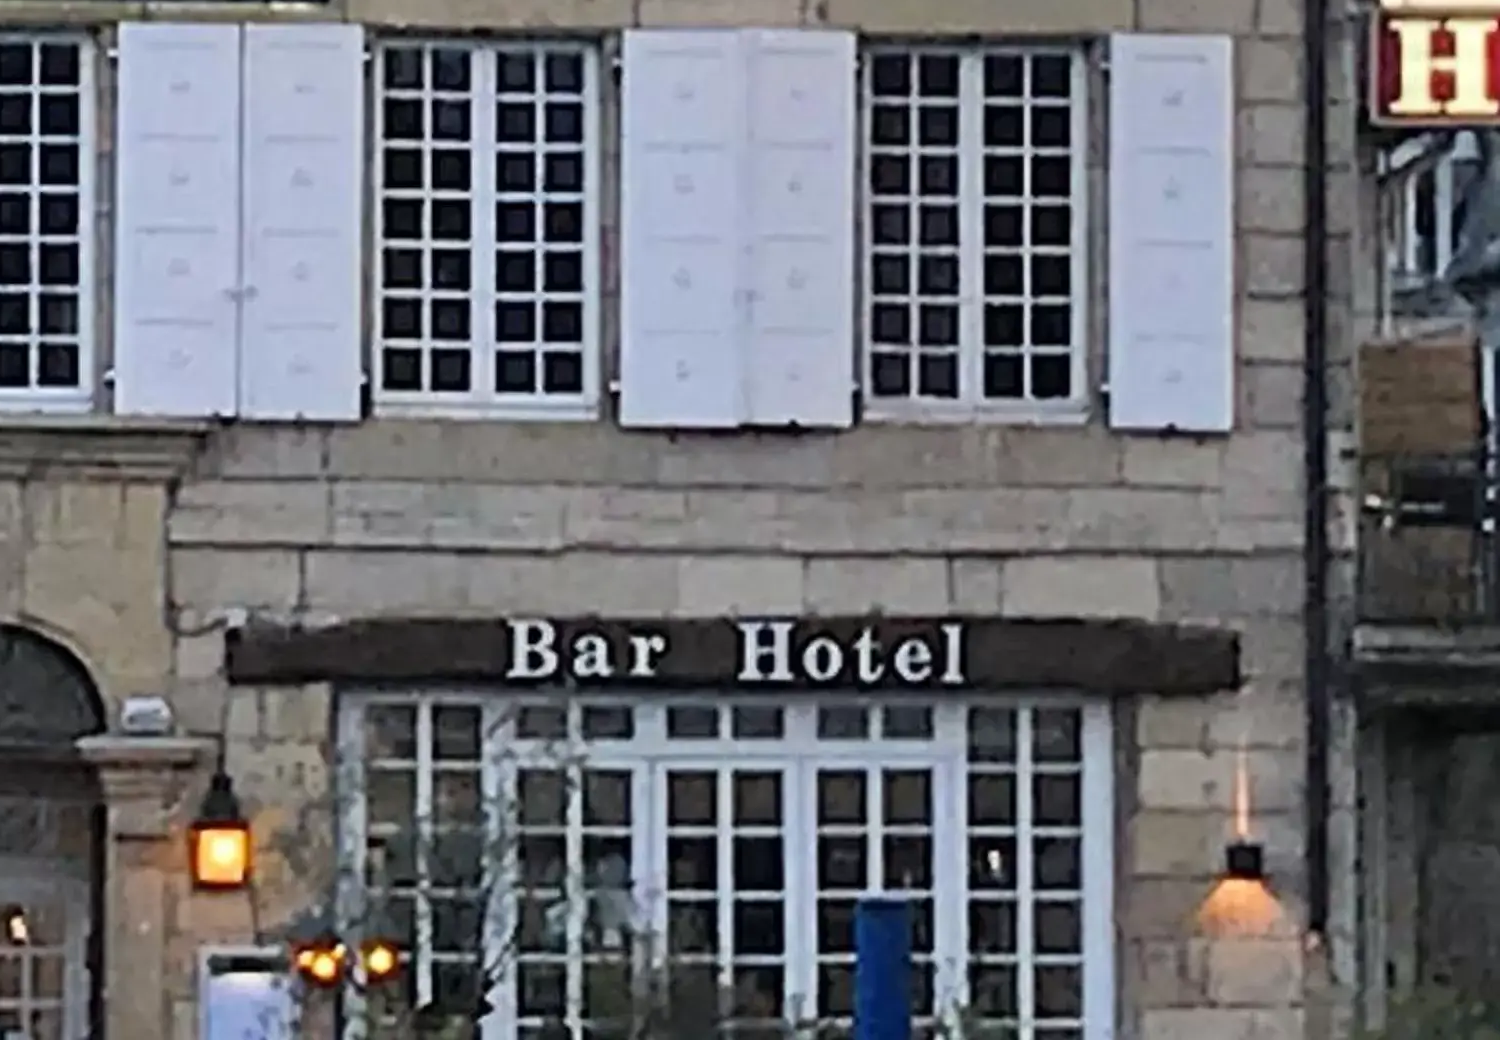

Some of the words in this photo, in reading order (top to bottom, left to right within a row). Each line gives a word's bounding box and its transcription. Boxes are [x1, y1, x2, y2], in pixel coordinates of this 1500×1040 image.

[1388, 20, 1499, 114] H
[505, 618, 665, 679] Bar
[737, 621, 966, 684] Hotel
